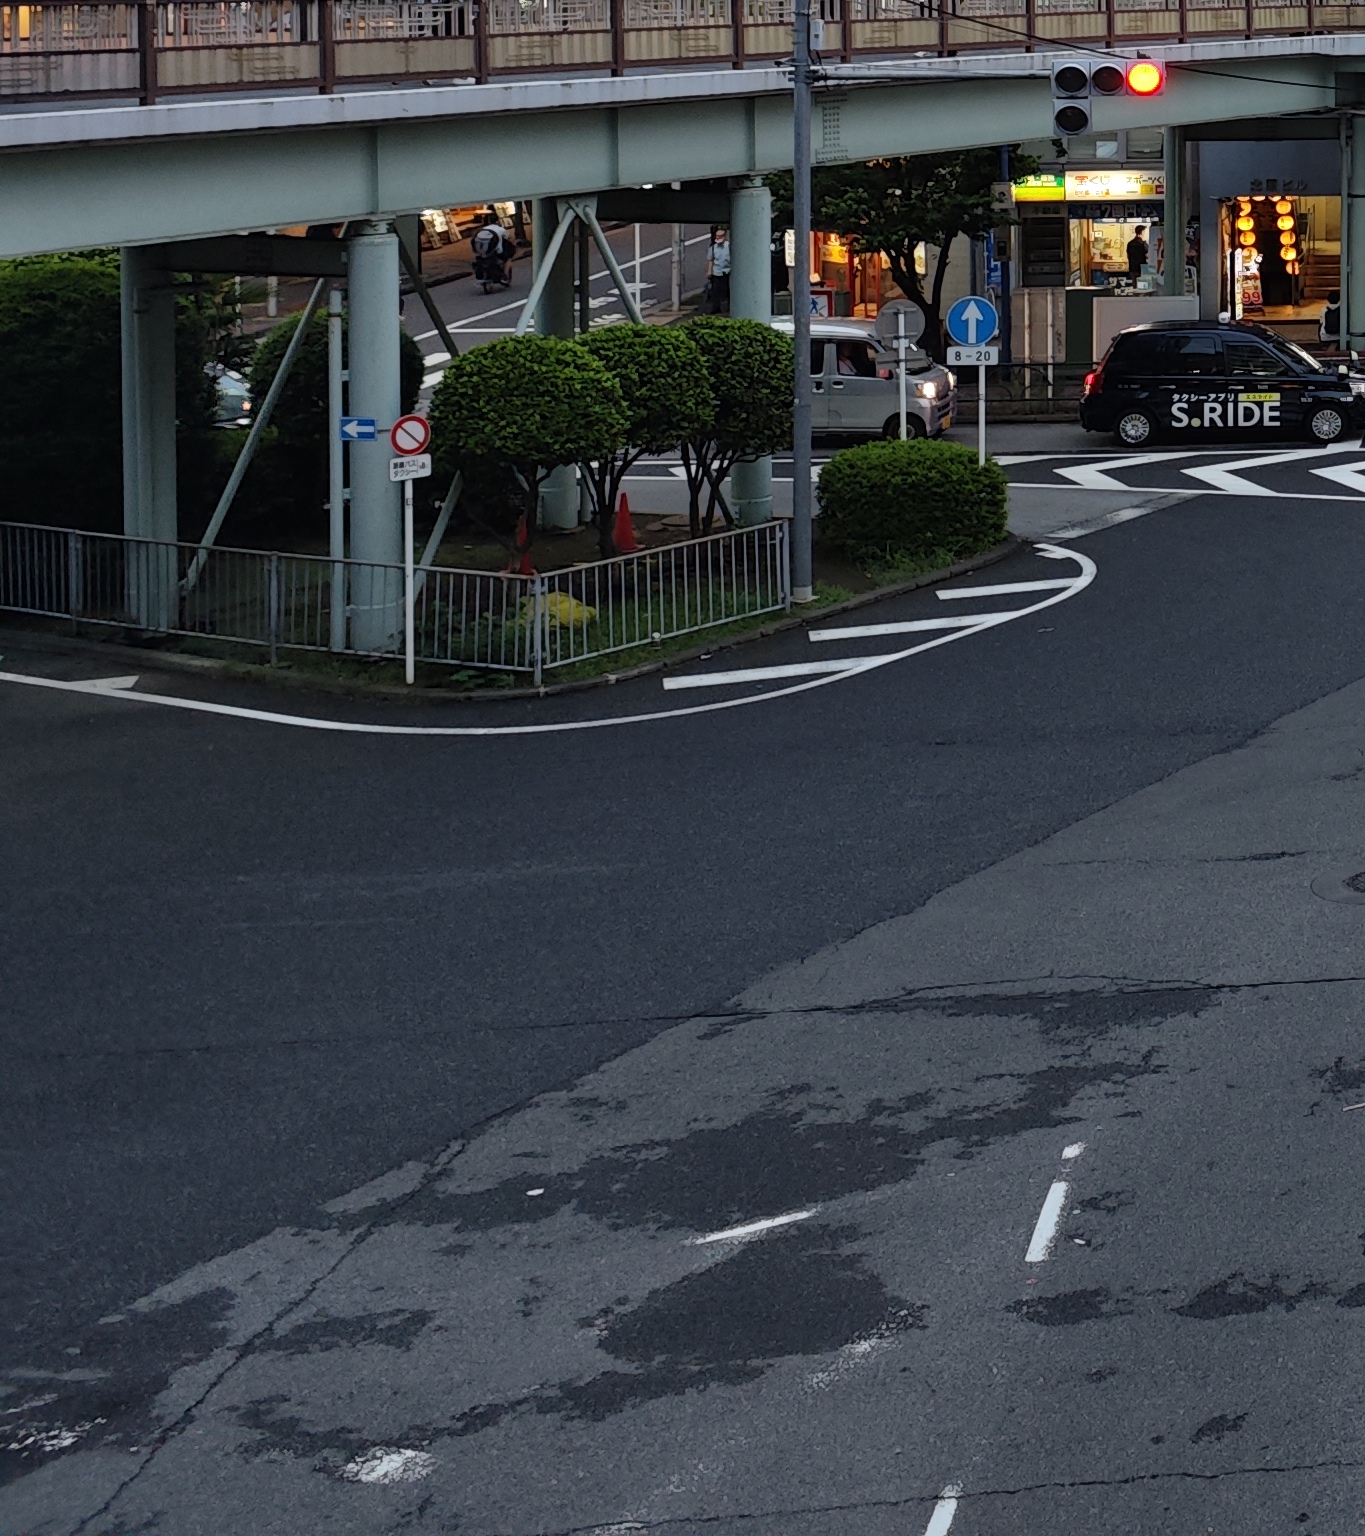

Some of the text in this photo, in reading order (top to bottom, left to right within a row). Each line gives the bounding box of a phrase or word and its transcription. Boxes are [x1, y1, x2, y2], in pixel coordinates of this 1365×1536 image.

[955, 350, 991, 362] 8-20
[1171, 393, 1236, 403] タクシーアプリ
[1170, 401, 1282, 428] S.RIDE
